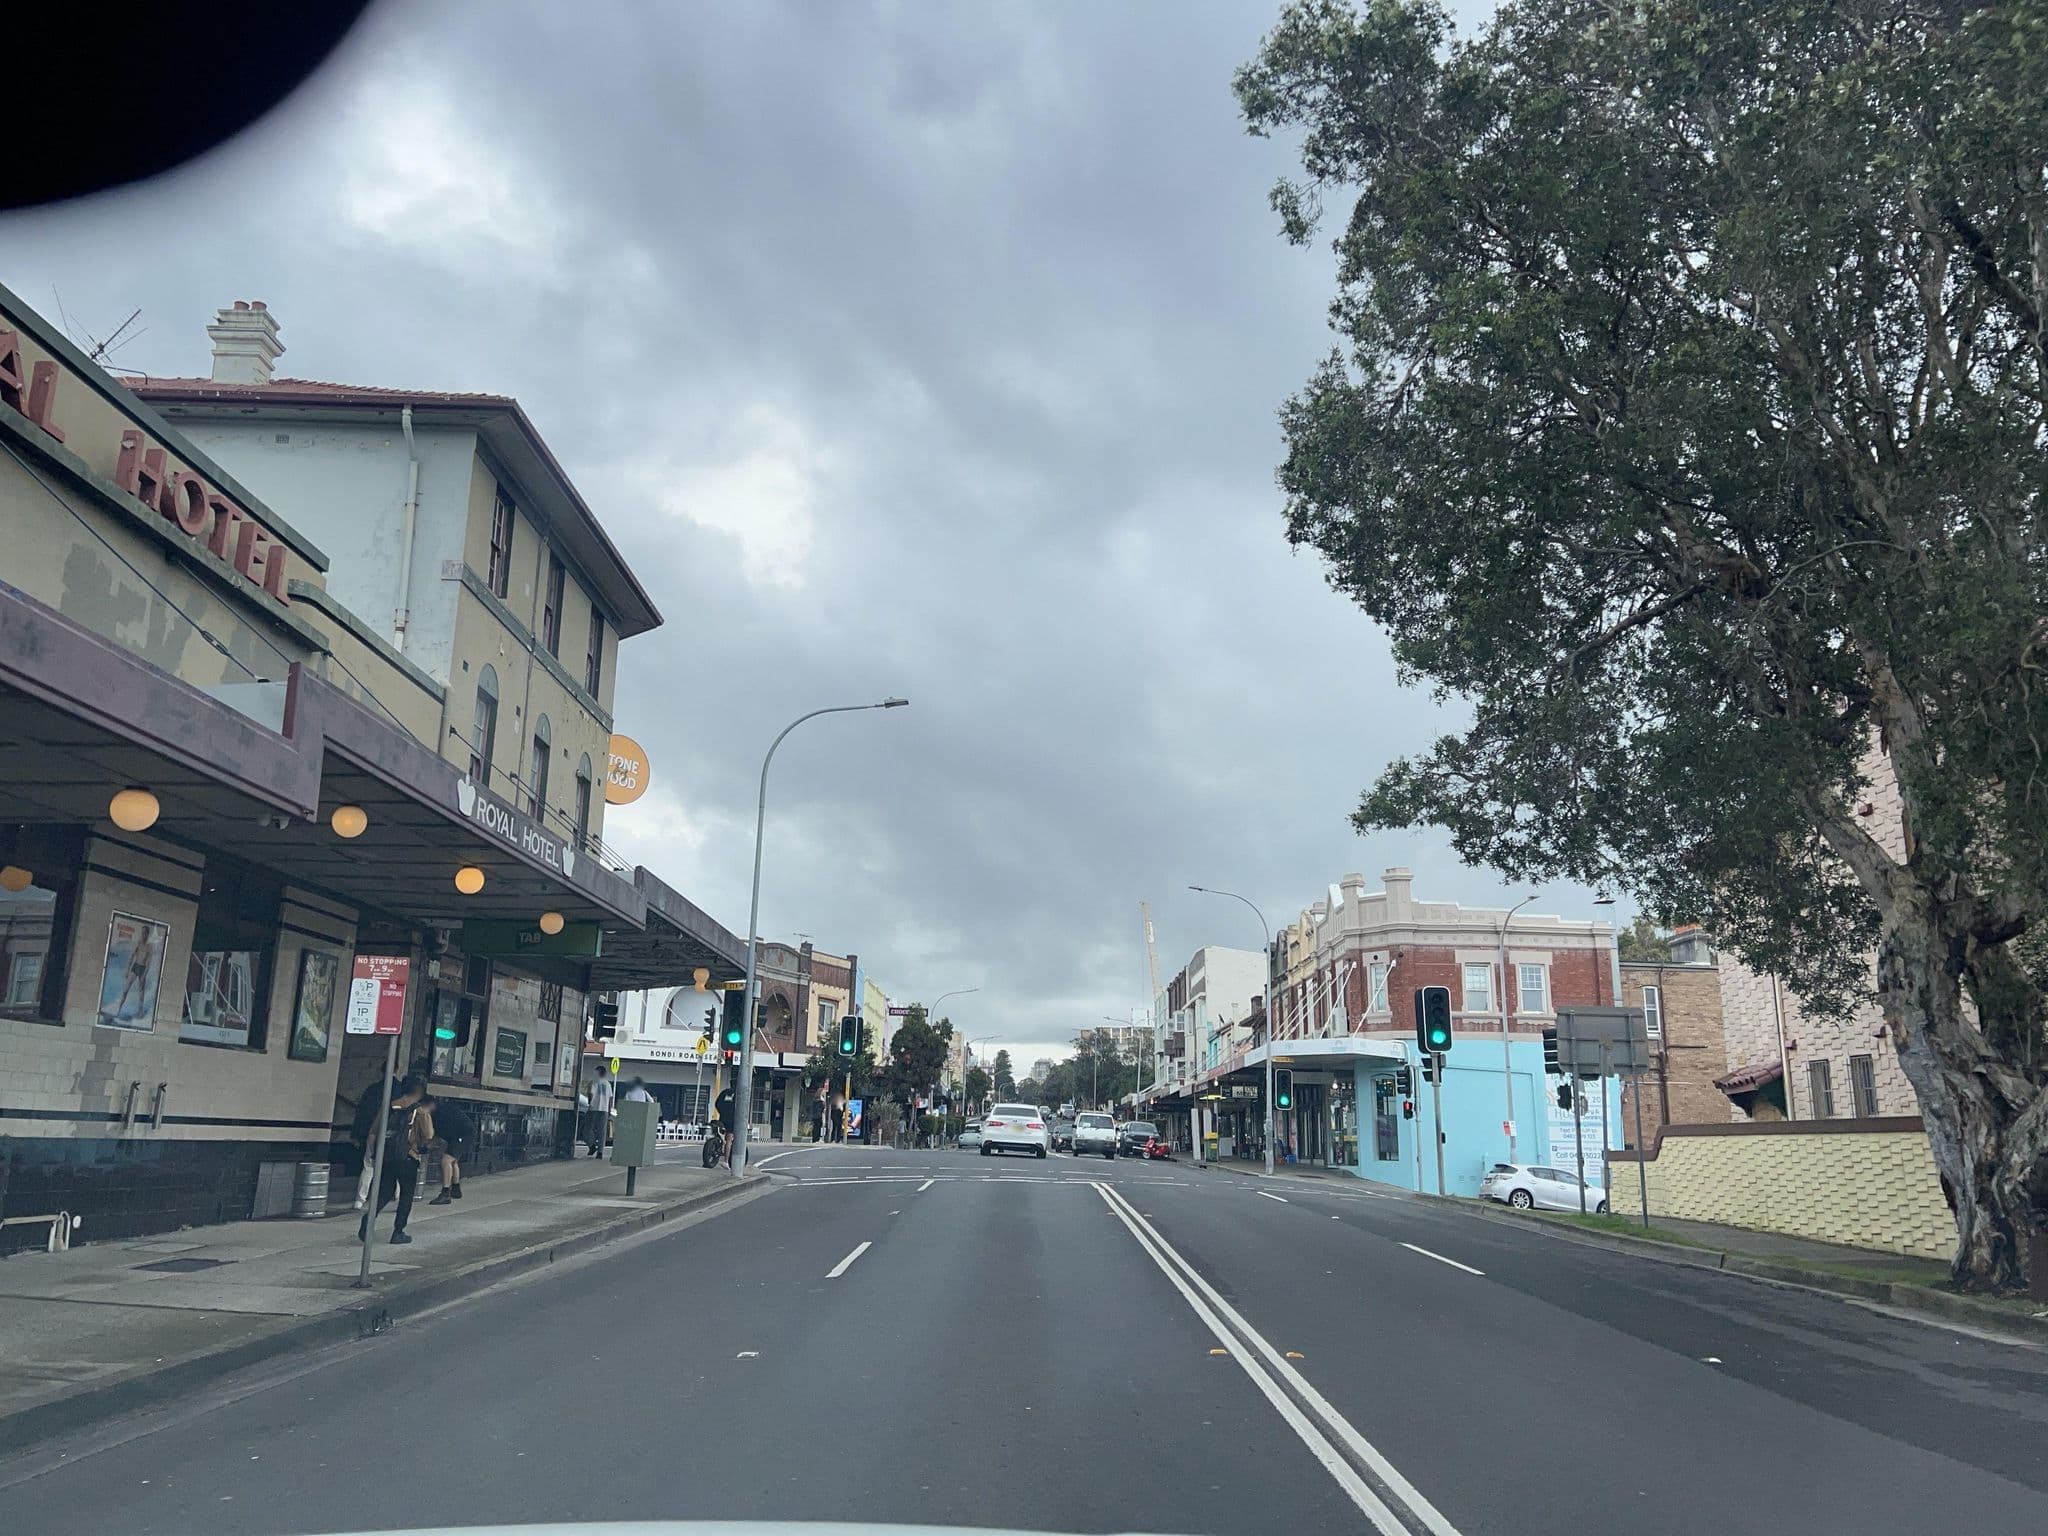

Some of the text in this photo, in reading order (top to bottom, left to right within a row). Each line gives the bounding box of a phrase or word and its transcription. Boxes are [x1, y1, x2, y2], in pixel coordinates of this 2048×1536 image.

[116, 430, 290, 608] HOTEL
[607, 771, 636, 789] OOD
[476, 796, 559, 868] ROYAL HOTEL
[519, 931, 542, 944] TAB
[357, 957, 408, 967] NO STOPPING
[357, 1007, 369, 1016] 1P
[650, 1050, 676, 1058] BONDI
[679, 1052, 700, 1060] ROAD
